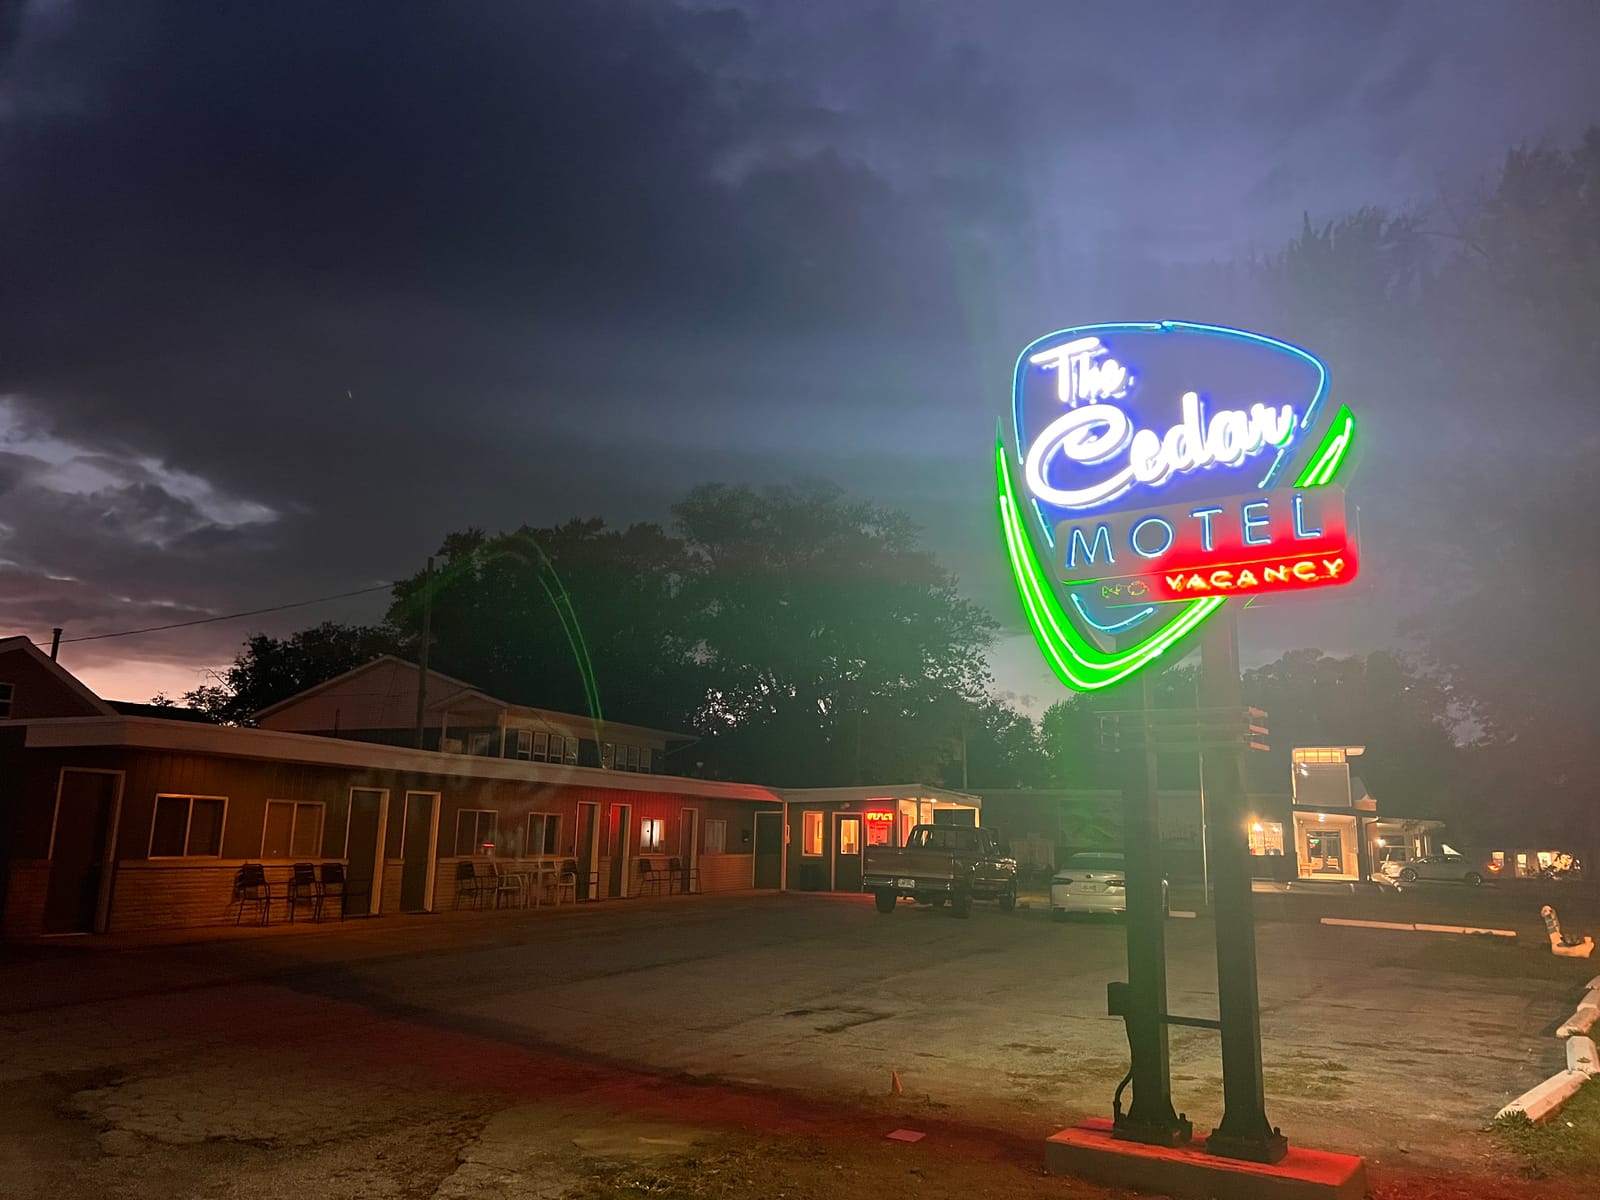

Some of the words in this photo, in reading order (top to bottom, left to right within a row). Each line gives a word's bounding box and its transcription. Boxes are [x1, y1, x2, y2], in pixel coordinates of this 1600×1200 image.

[1030, 337, 1130, 406] The
[1026, 391, 1296, 508] Cedar
[1066, 494, 1321, 568] MOTEL
[1166, 558, 1344, 592] VACANCY
